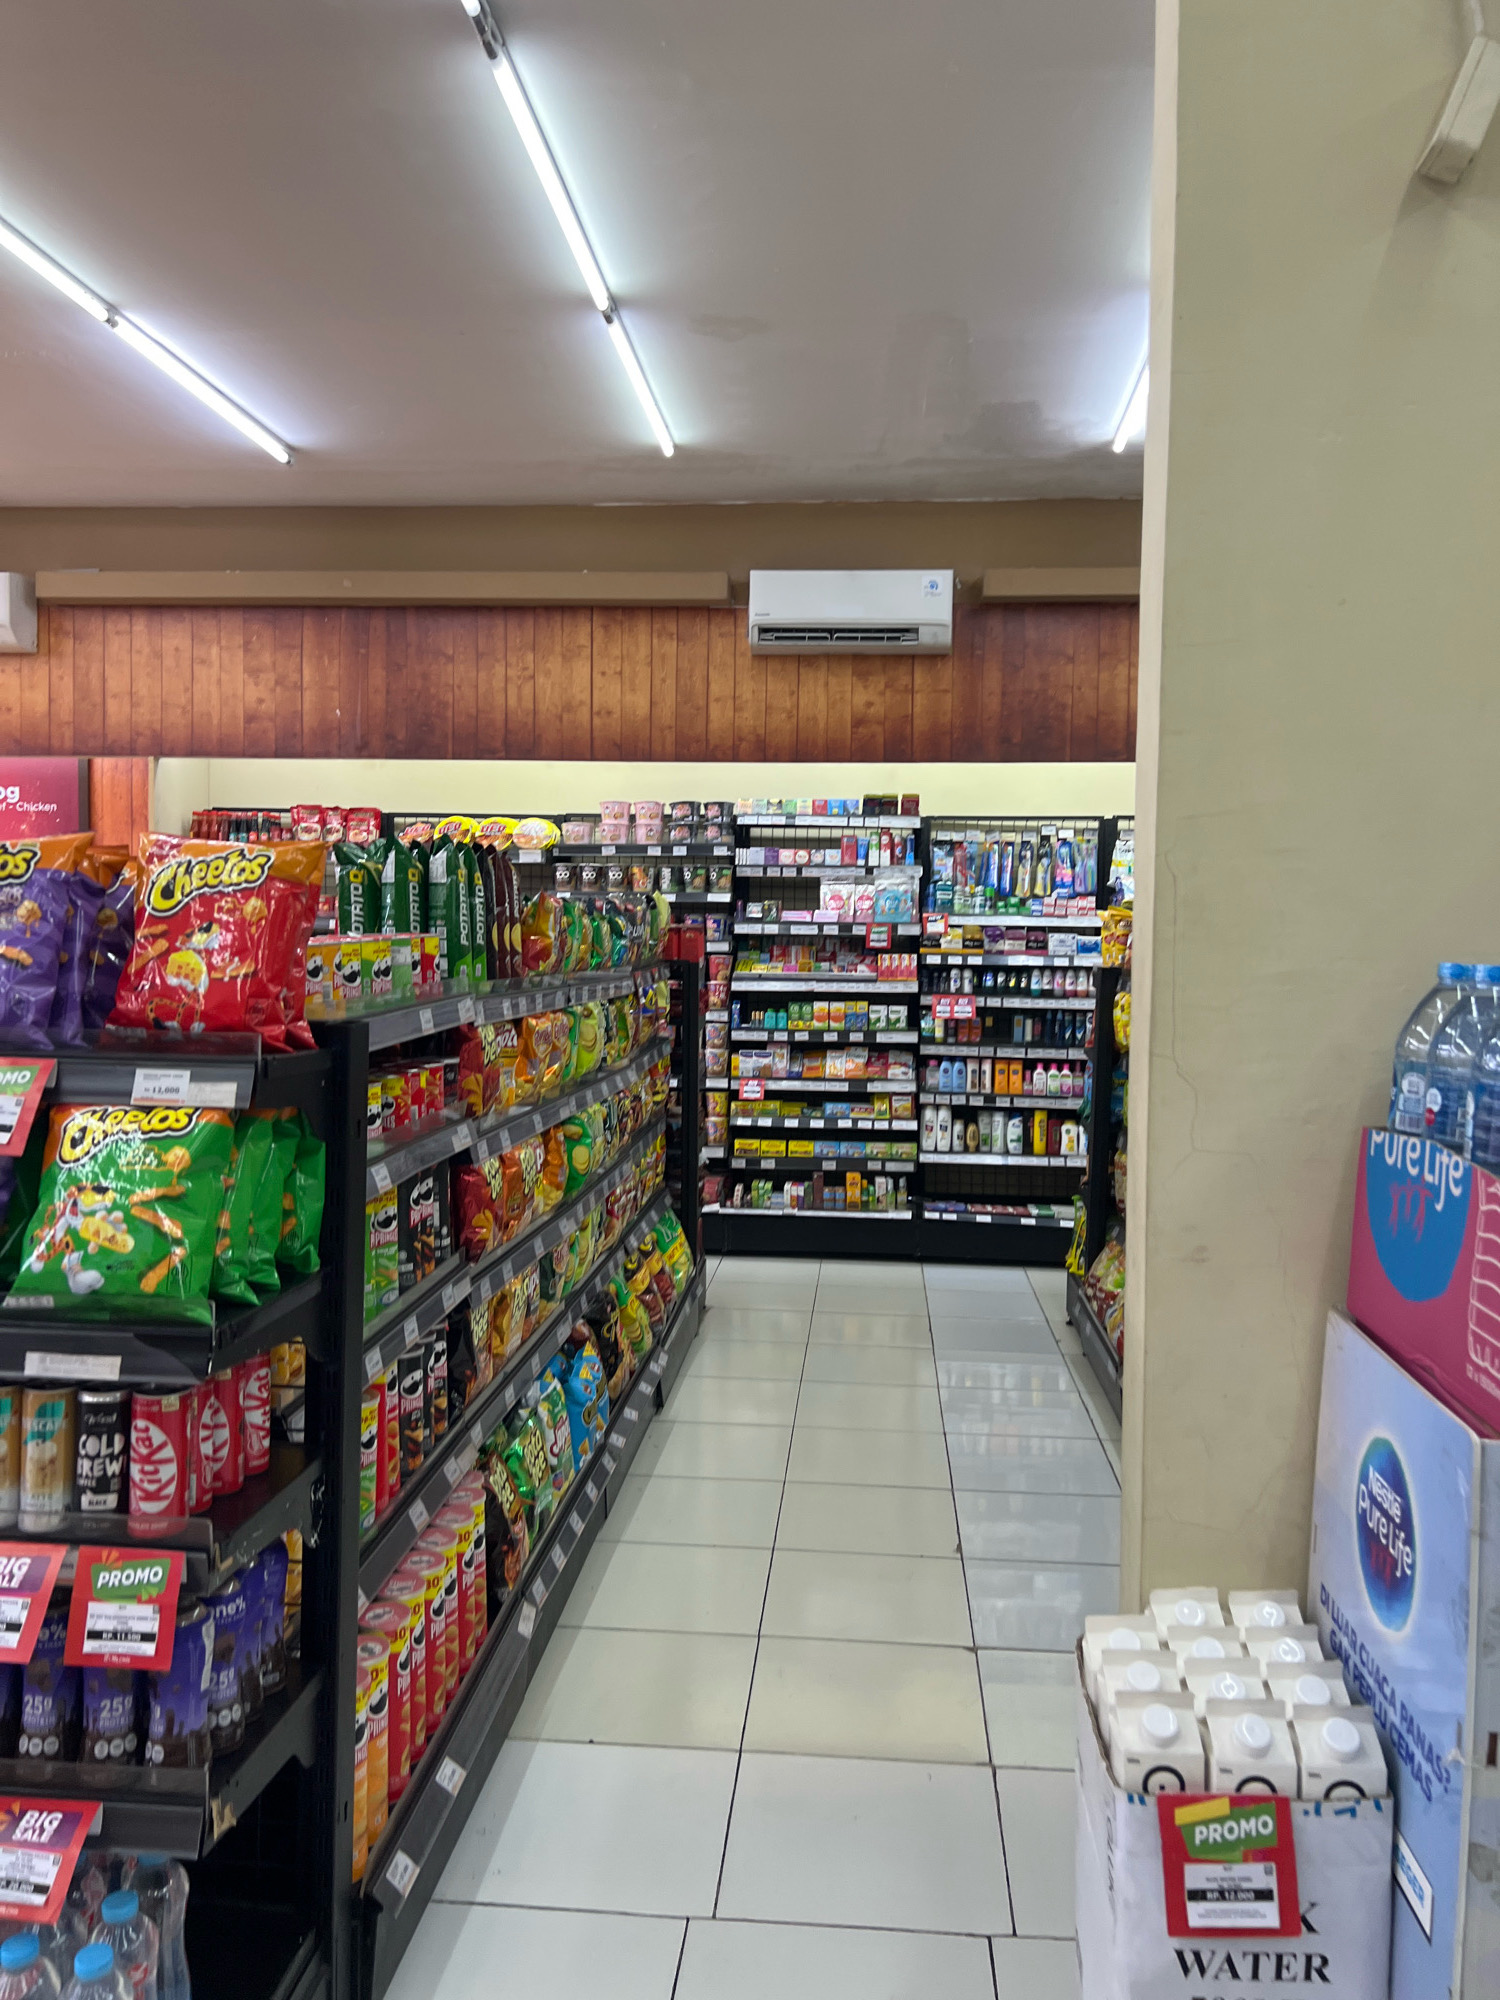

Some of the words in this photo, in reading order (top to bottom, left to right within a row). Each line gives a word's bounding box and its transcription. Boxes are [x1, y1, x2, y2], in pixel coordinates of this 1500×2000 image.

[16, 802, 57, 812] Chicken
[0, 848, 35, 878] os
[150, 848, 268, 912] Cheetos
[0, 1070, 31, 1085] MO
[1370, 1130, 1421, 1177] Pure
[1423, 1140, 1464, 1212] Life
[79, 1433, 126, 1457] COLD
[1359, 1482, 1388, 1546] Pure
[1389, 1521, 1412, 1578] Life
[97, 1565, 163, 1589] PROMO
[1320, 1582, 1330, 1613] DI
[1331, 1597, 1358, 1651] LUAR
[1359, 1641, 1397, 1716] CUACA
[1400, 1700, 1451, 1794] PANAS?
[1329, 1627, 1351, 1678] GAK
[1353, 1660, 1387, 1731] PERLU
[1389, 1722, 1432, 1803] CEMAS
[20, 1810, 63, 1830] BIG
[1194, 1815, 1274, 1846] PROMO
[1173, 1947, 1332, 1985] WATER
